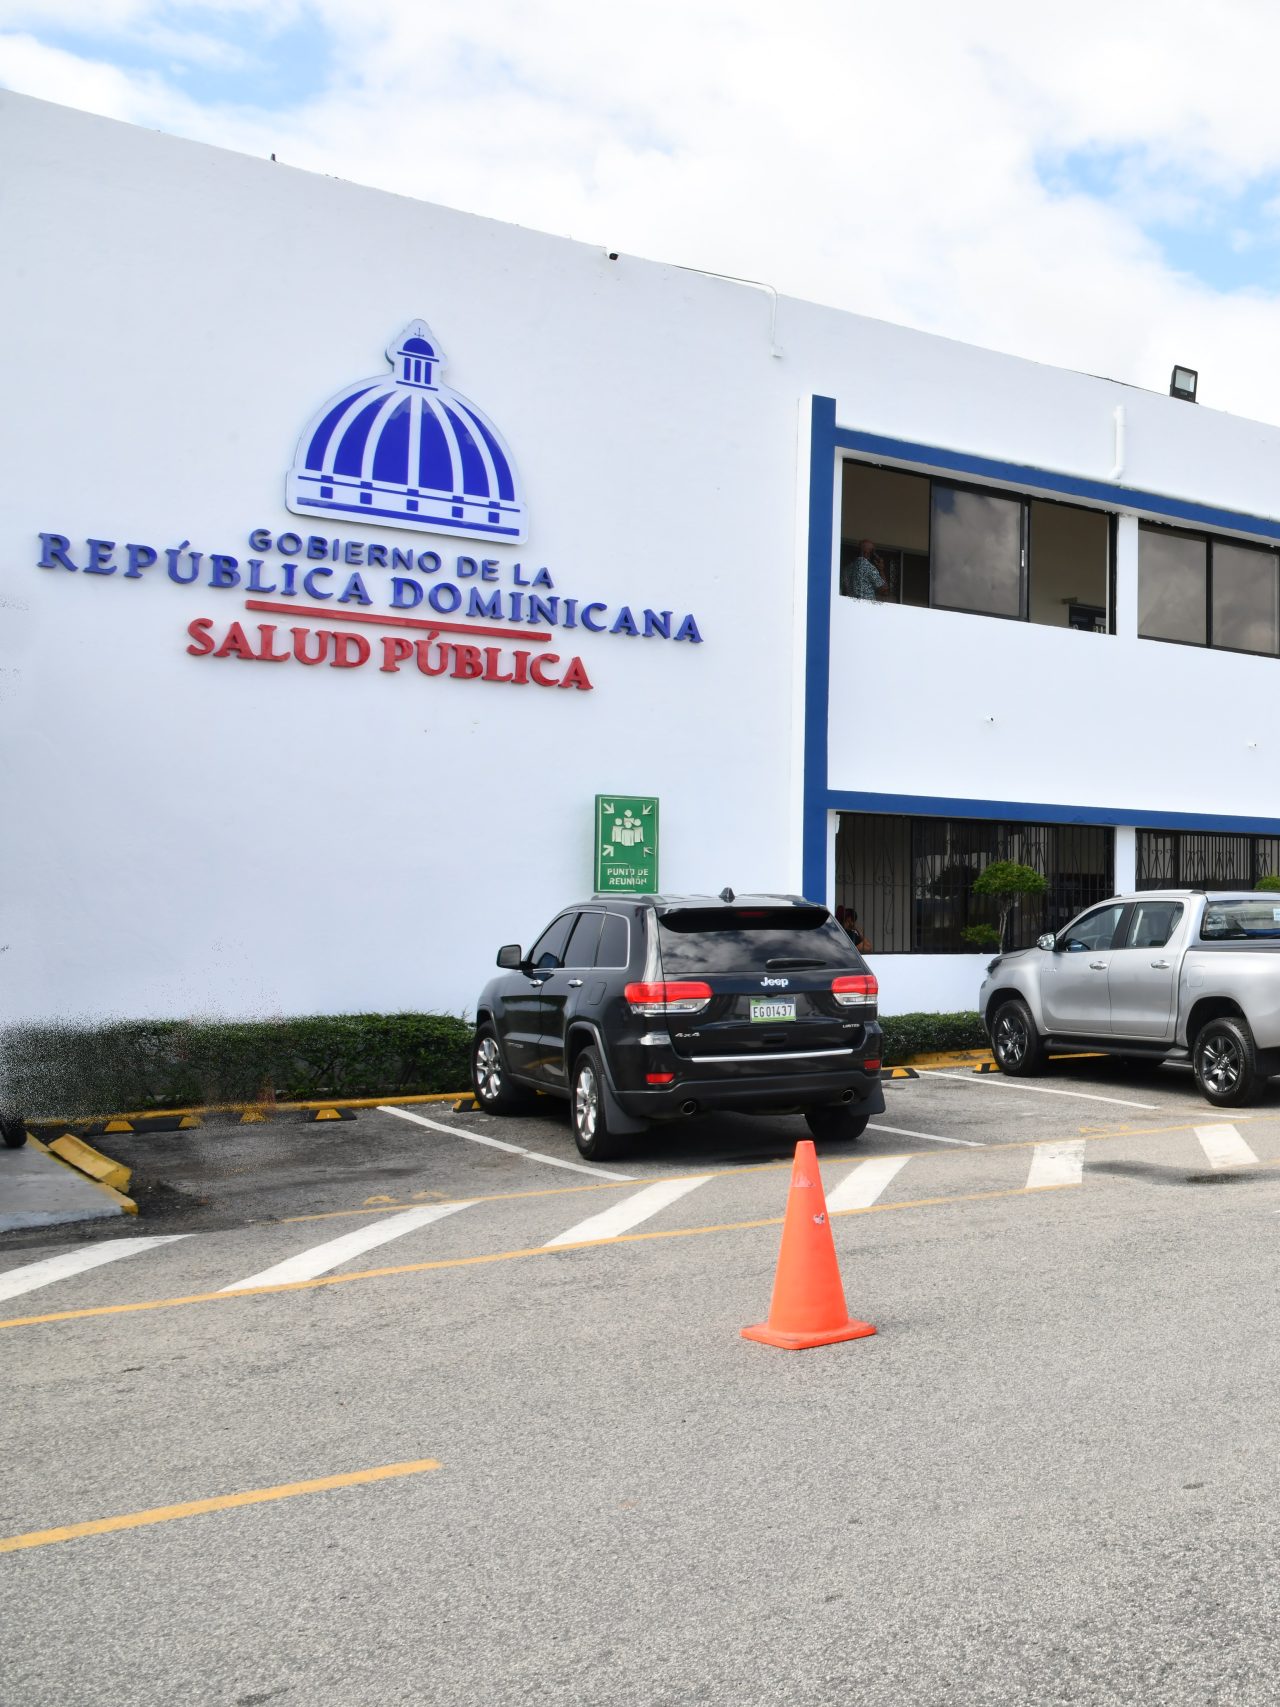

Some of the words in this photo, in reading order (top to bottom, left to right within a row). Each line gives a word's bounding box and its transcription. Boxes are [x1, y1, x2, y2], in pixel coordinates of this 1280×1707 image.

[250, 528, 442, 574] GOBIERNO
[457, 555, 500, 582] DE
[513, 563, 555, 589] LA
[36, 532, 373, 606] REPÚBLICA
[389, 577, 704, 644] DOMINICANA
[186, 618, 371, 668] SALUD
[380, 631, 594, 690] PÚBLICA
[607, 868, 635, 876] PUNTO
[637, 868, 649, 876] DE
[760, 976, 789, 988] Jeep
[753, 1004, 792, 1018] EG01437
